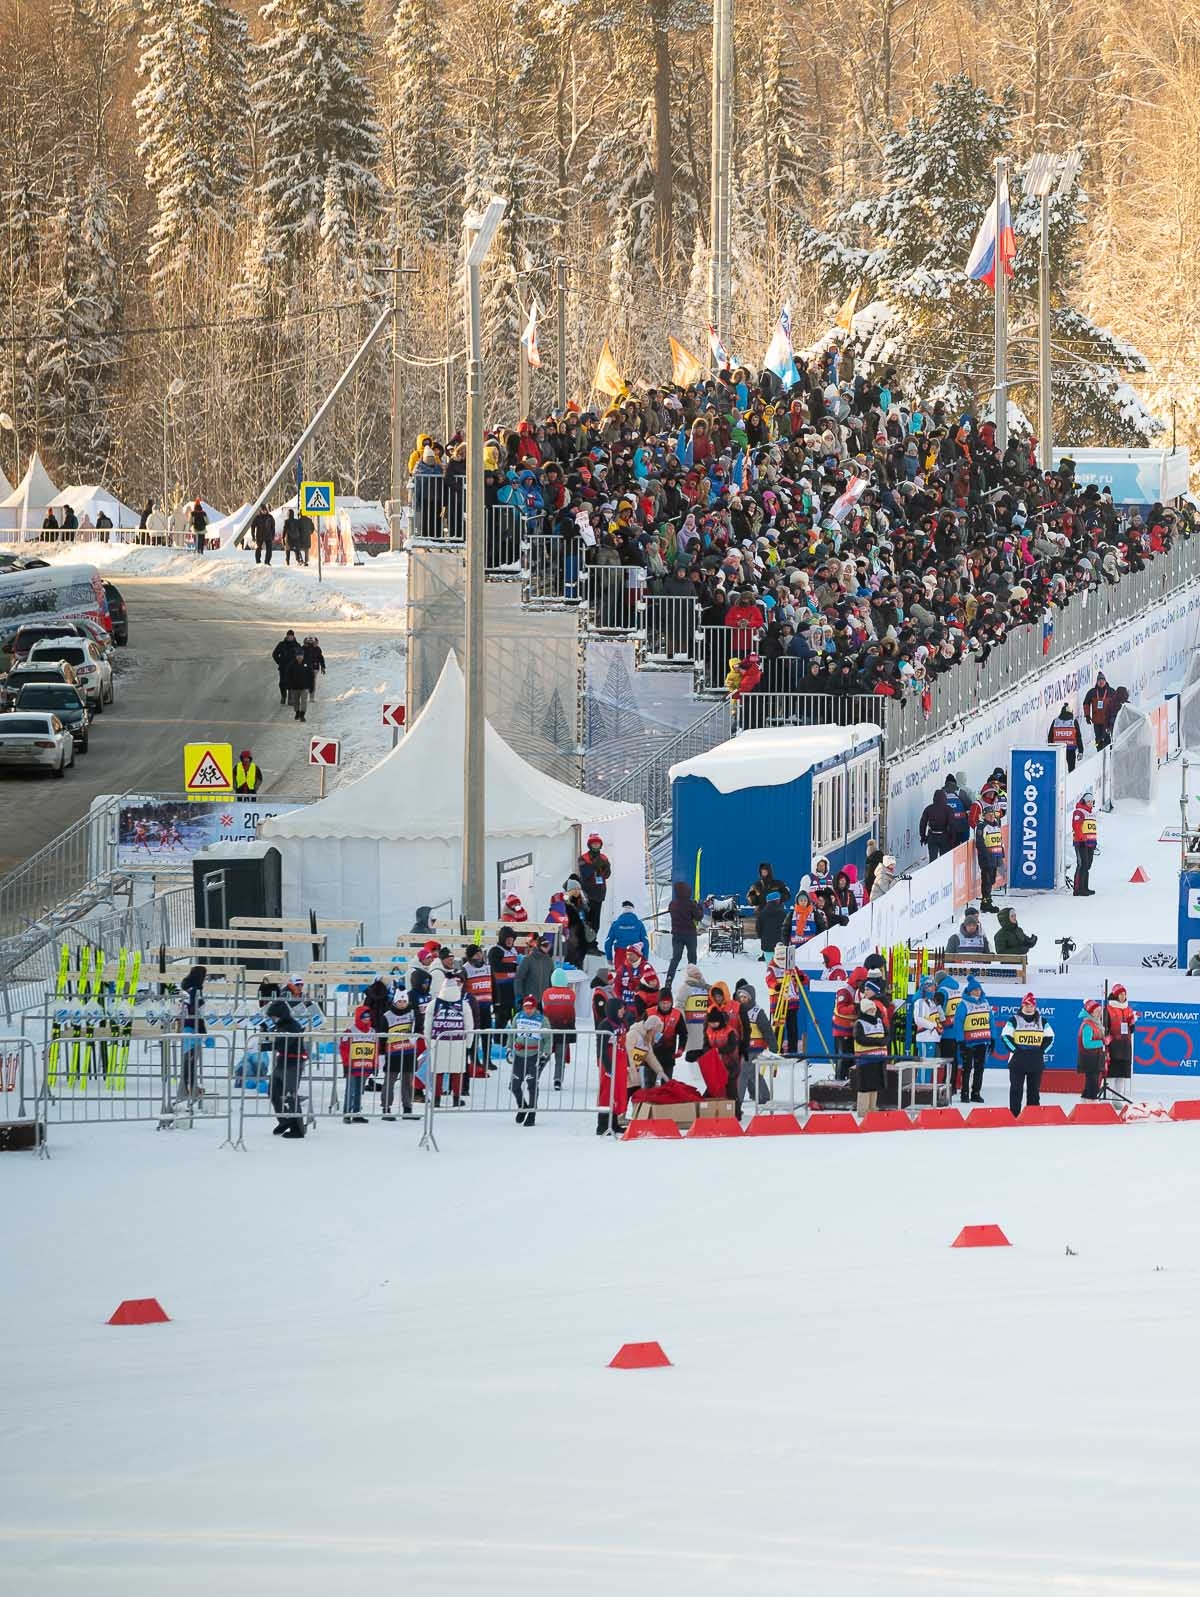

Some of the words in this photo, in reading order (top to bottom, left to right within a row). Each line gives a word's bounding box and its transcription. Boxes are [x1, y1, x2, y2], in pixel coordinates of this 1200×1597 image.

[1023, 785, 1039, 876] ФОСАГРО
[1144, 1011, 1199, 1020] РУСКЛИМАТ
[1018, 1035, 1041, 1043] СУДЬЯ
[1134, 1026, 1193, 1067] 30
[1179, 1059, 1199, 1067] ЛЕТ
